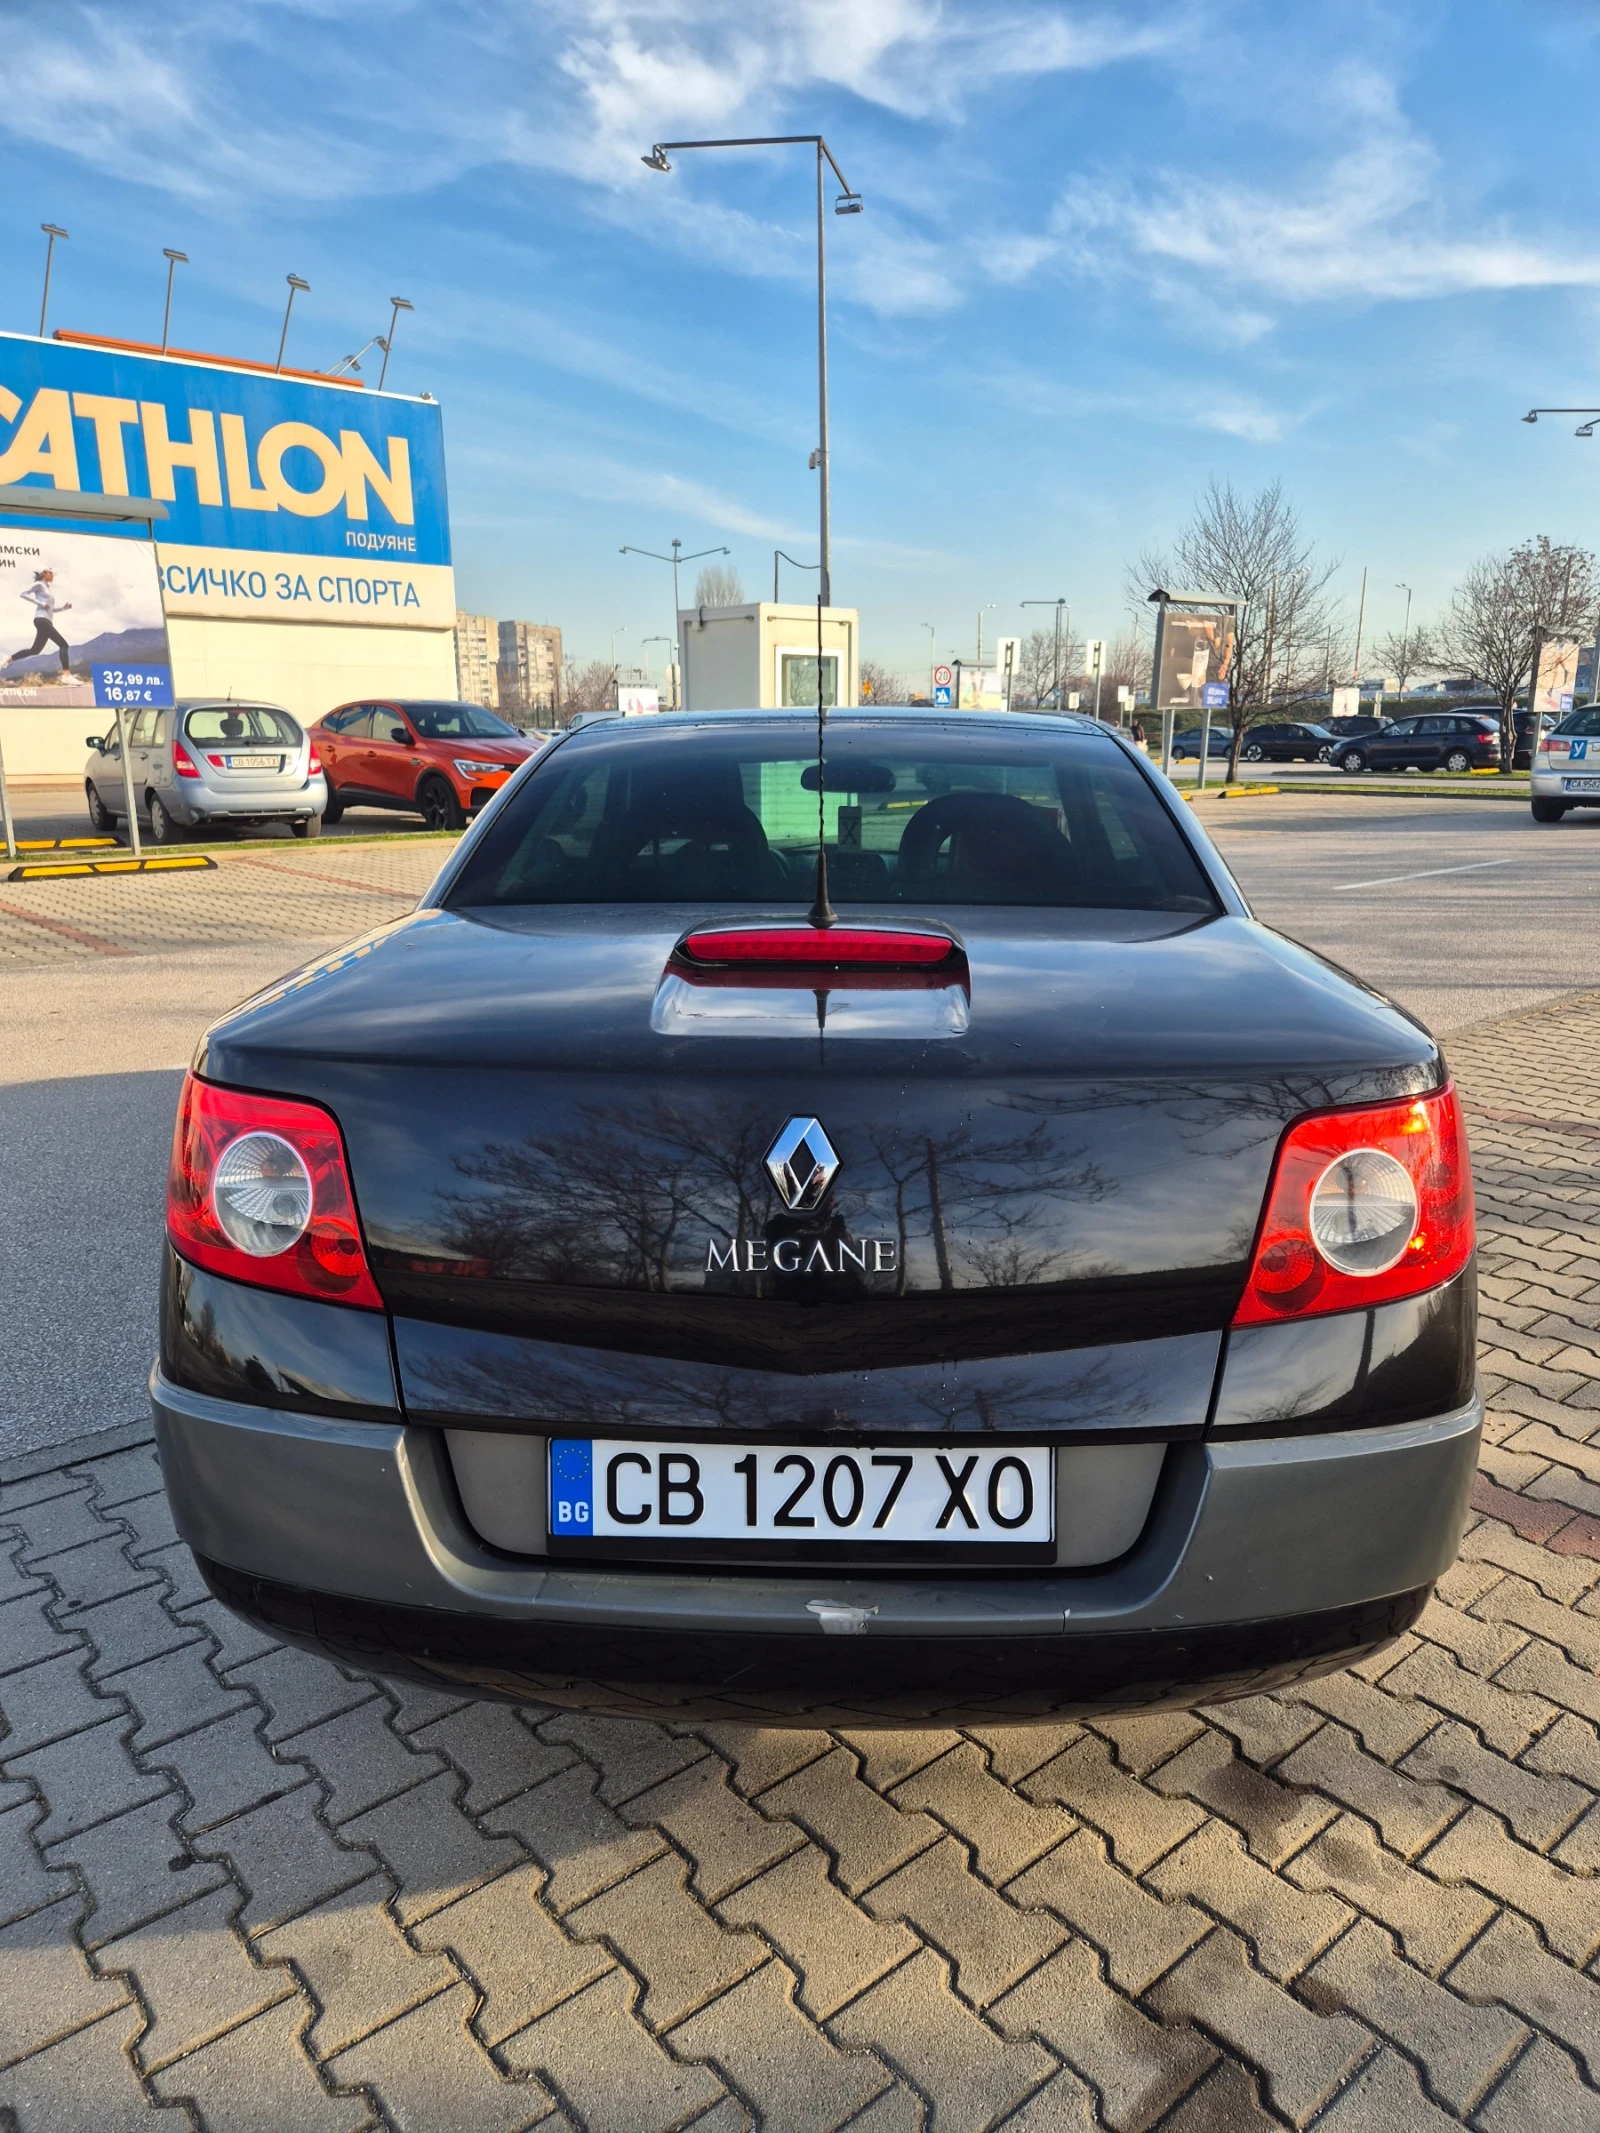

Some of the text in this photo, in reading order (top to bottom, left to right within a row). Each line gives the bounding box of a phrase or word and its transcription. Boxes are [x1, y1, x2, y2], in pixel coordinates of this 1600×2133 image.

[345, 531, 417, 552] ПОДУЯНЕ
[274, 573, 312, 601] ЗА
[318, 576, 421, 607] СПОРТА
[103, 670, 164, 686] 32,99 лв.
[938, 671, 948, 681] 20
[104, 687, 152, 703] 16,87 €
[705, 1238, 897, 1272] MEGANE
[606, 1452, 1034, 1529] CB 1207 XO
[558, 1501, 589, 1523] BG
